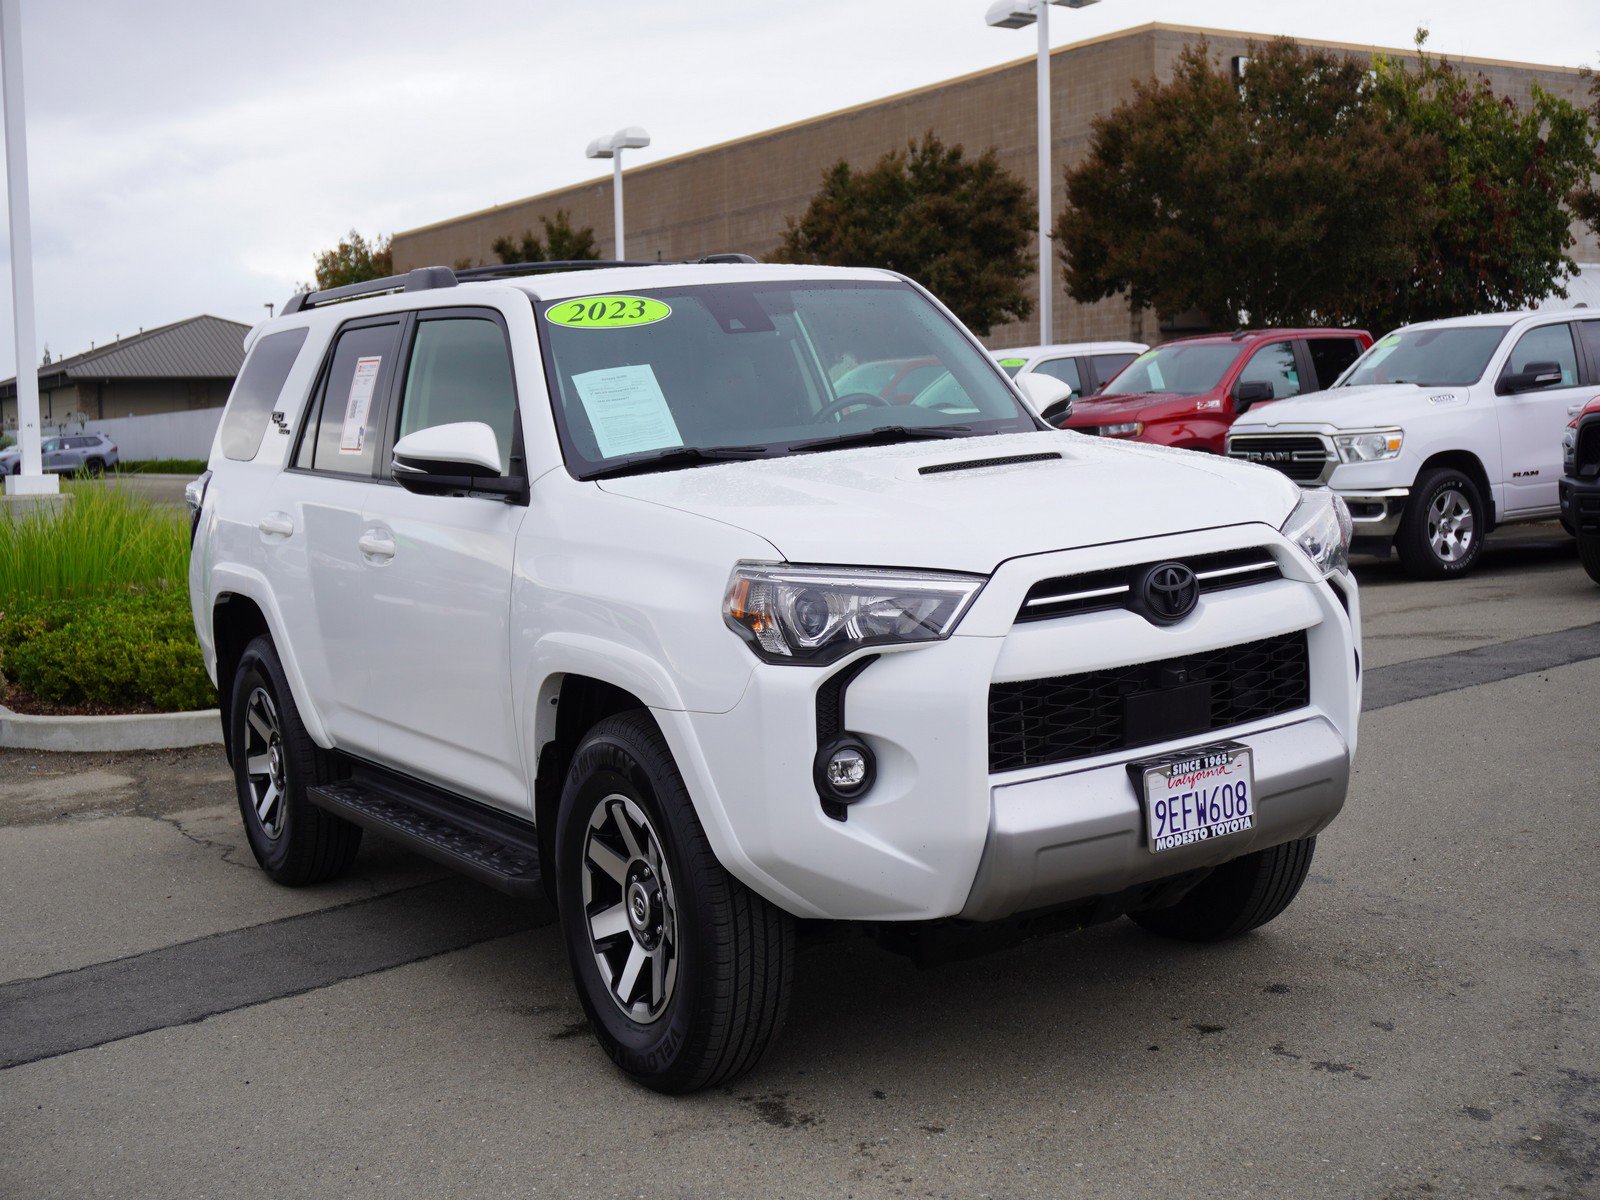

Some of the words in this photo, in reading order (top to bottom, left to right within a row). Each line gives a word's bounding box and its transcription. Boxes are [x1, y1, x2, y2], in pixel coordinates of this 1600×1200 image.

[567, 300, 646, 323] 2023
[1250, 451, 1290, 461] RAM
[1512, 469, 1540, 478] RAM
[1172, 759, 1201, 776] SINCE
[1204, 753, 1228, 769] 1965
[1167, 765, 1233, 789] California
[1155, 780, 1248, 837] 9EFW608
[1156, 827, 1209, 851] MODESTO
[1211, 816, 1252, 837] TOYOTA
